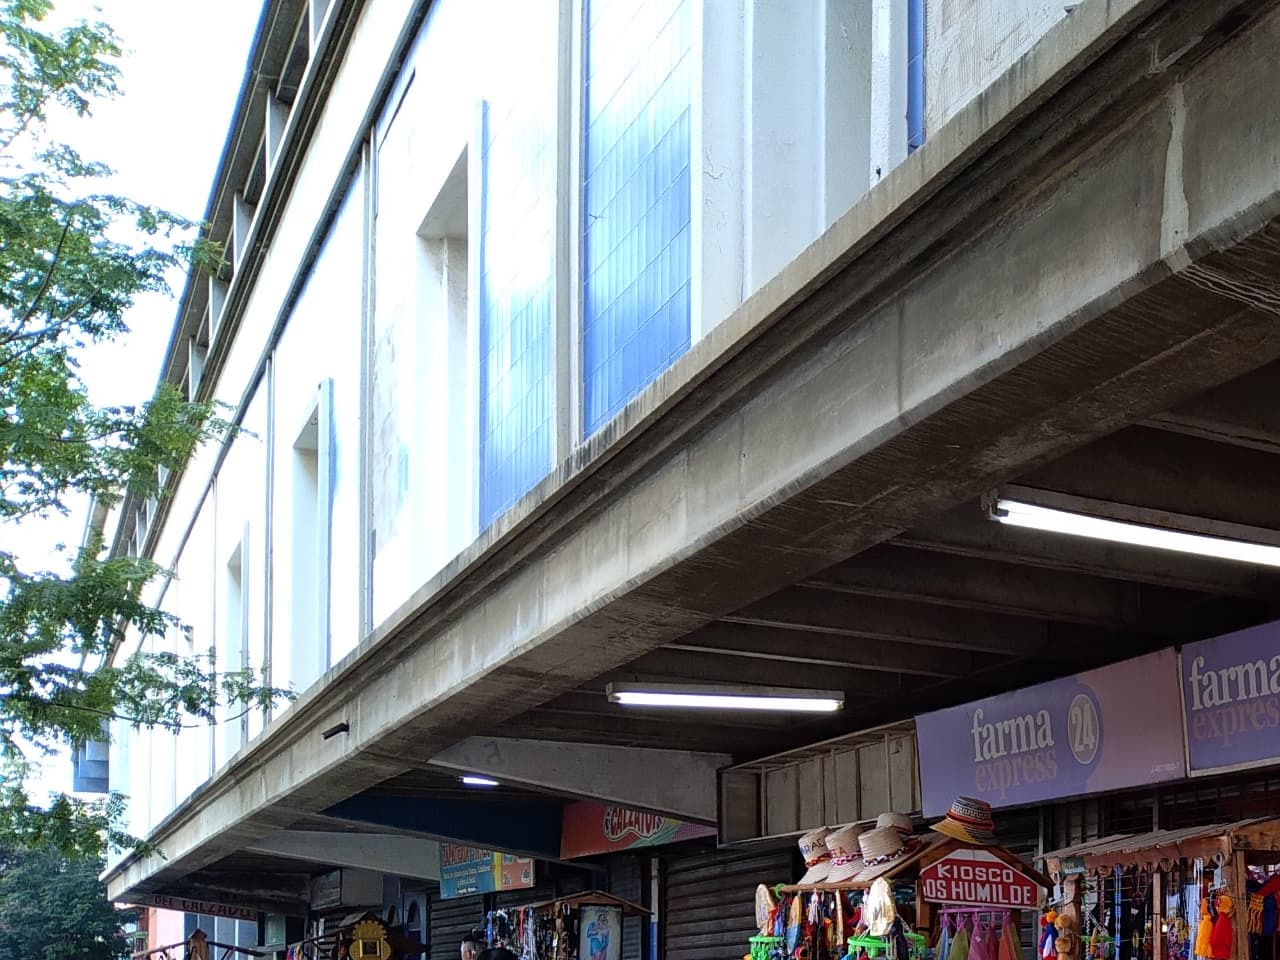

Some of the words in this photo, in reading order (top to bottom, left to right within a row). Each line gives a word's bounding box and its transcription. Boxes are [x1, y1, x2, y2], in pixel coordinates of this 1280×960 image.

[970, 708, 1055, 763] farma
[1071, 702, 1095, 753] 24
[975, 750, 1057, 799] express
[937, 863, 1014, 883] KIOSCO
[951, 882, 1032, 905] HUMILDE
